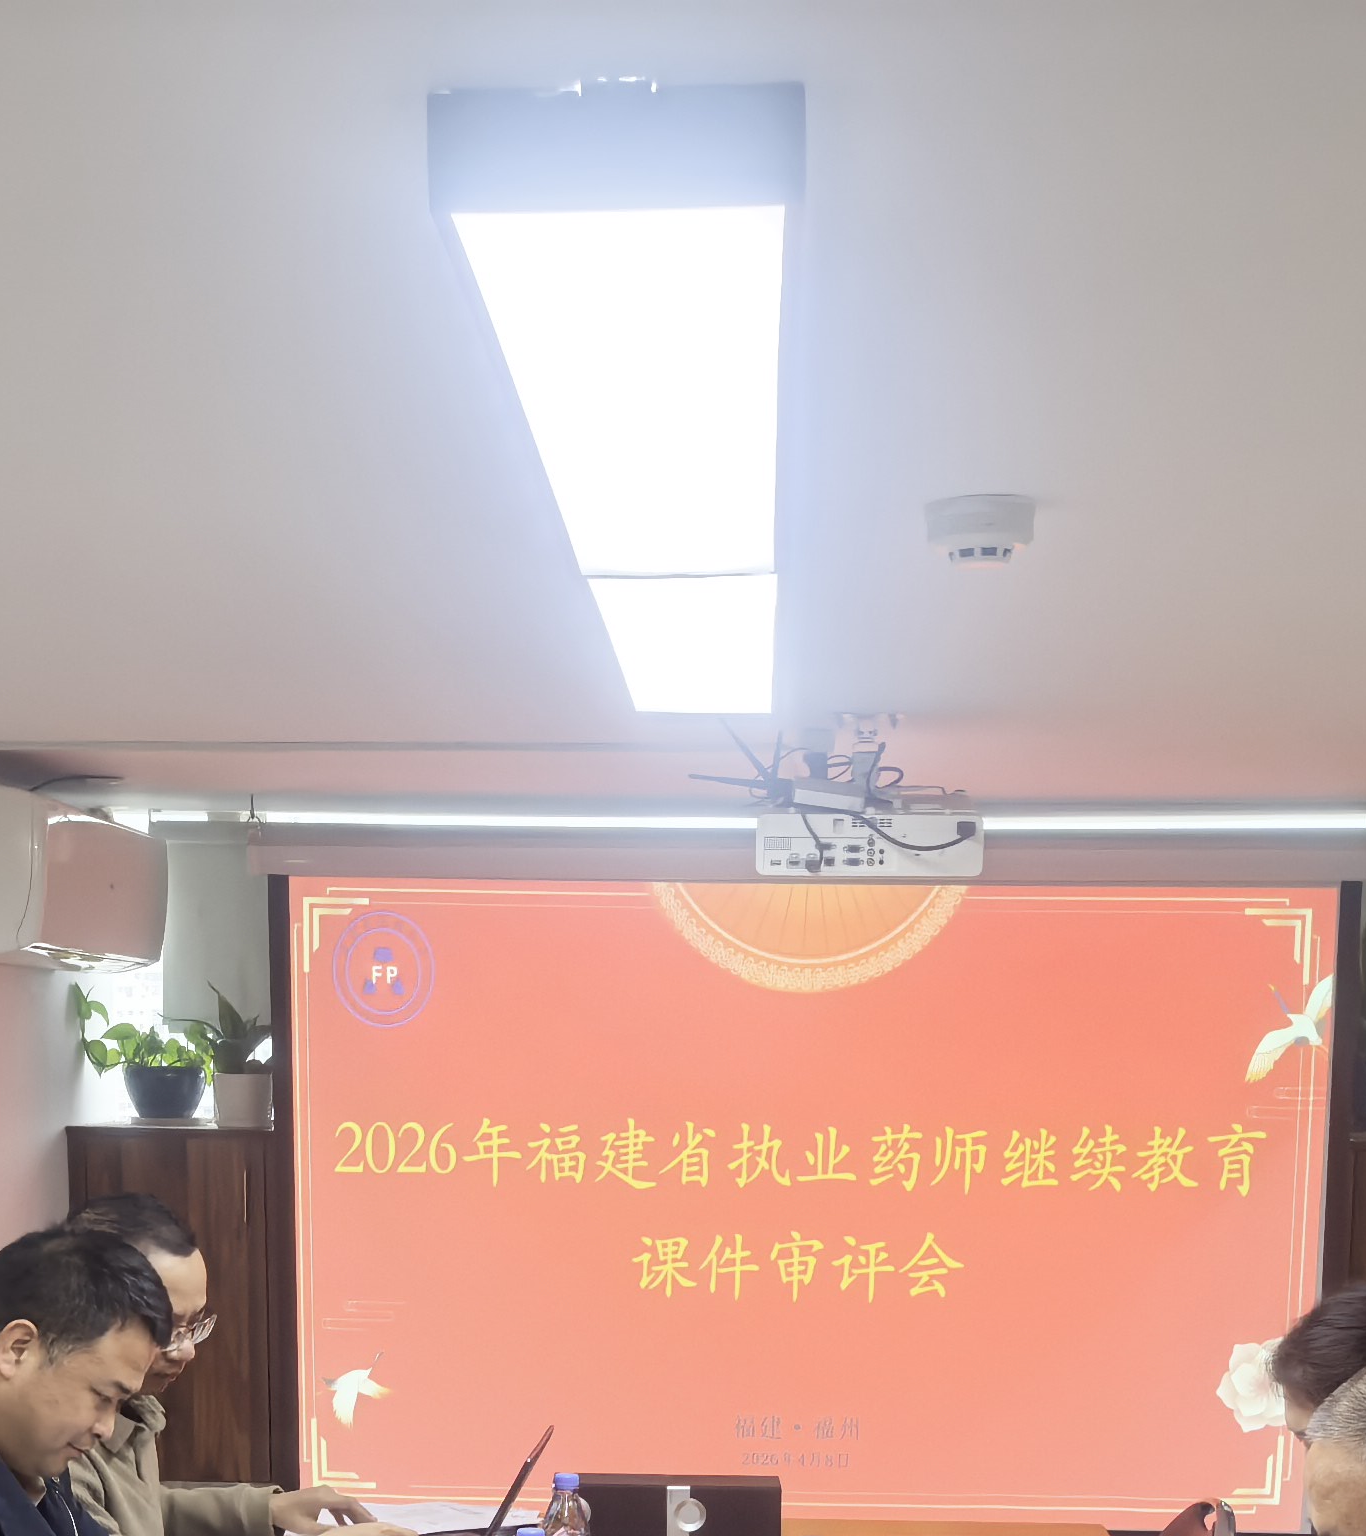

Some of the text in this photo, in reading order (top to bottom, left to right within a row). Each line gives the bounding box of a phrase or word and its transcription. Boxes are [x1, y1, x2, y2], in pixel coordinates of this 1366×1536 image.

[372, 965, 398, 985] FP
[335, 1117, 1269, 1198] 2026年福建省执业药师继续教育
[633, 1230, 966, 1304] 课件审评会
